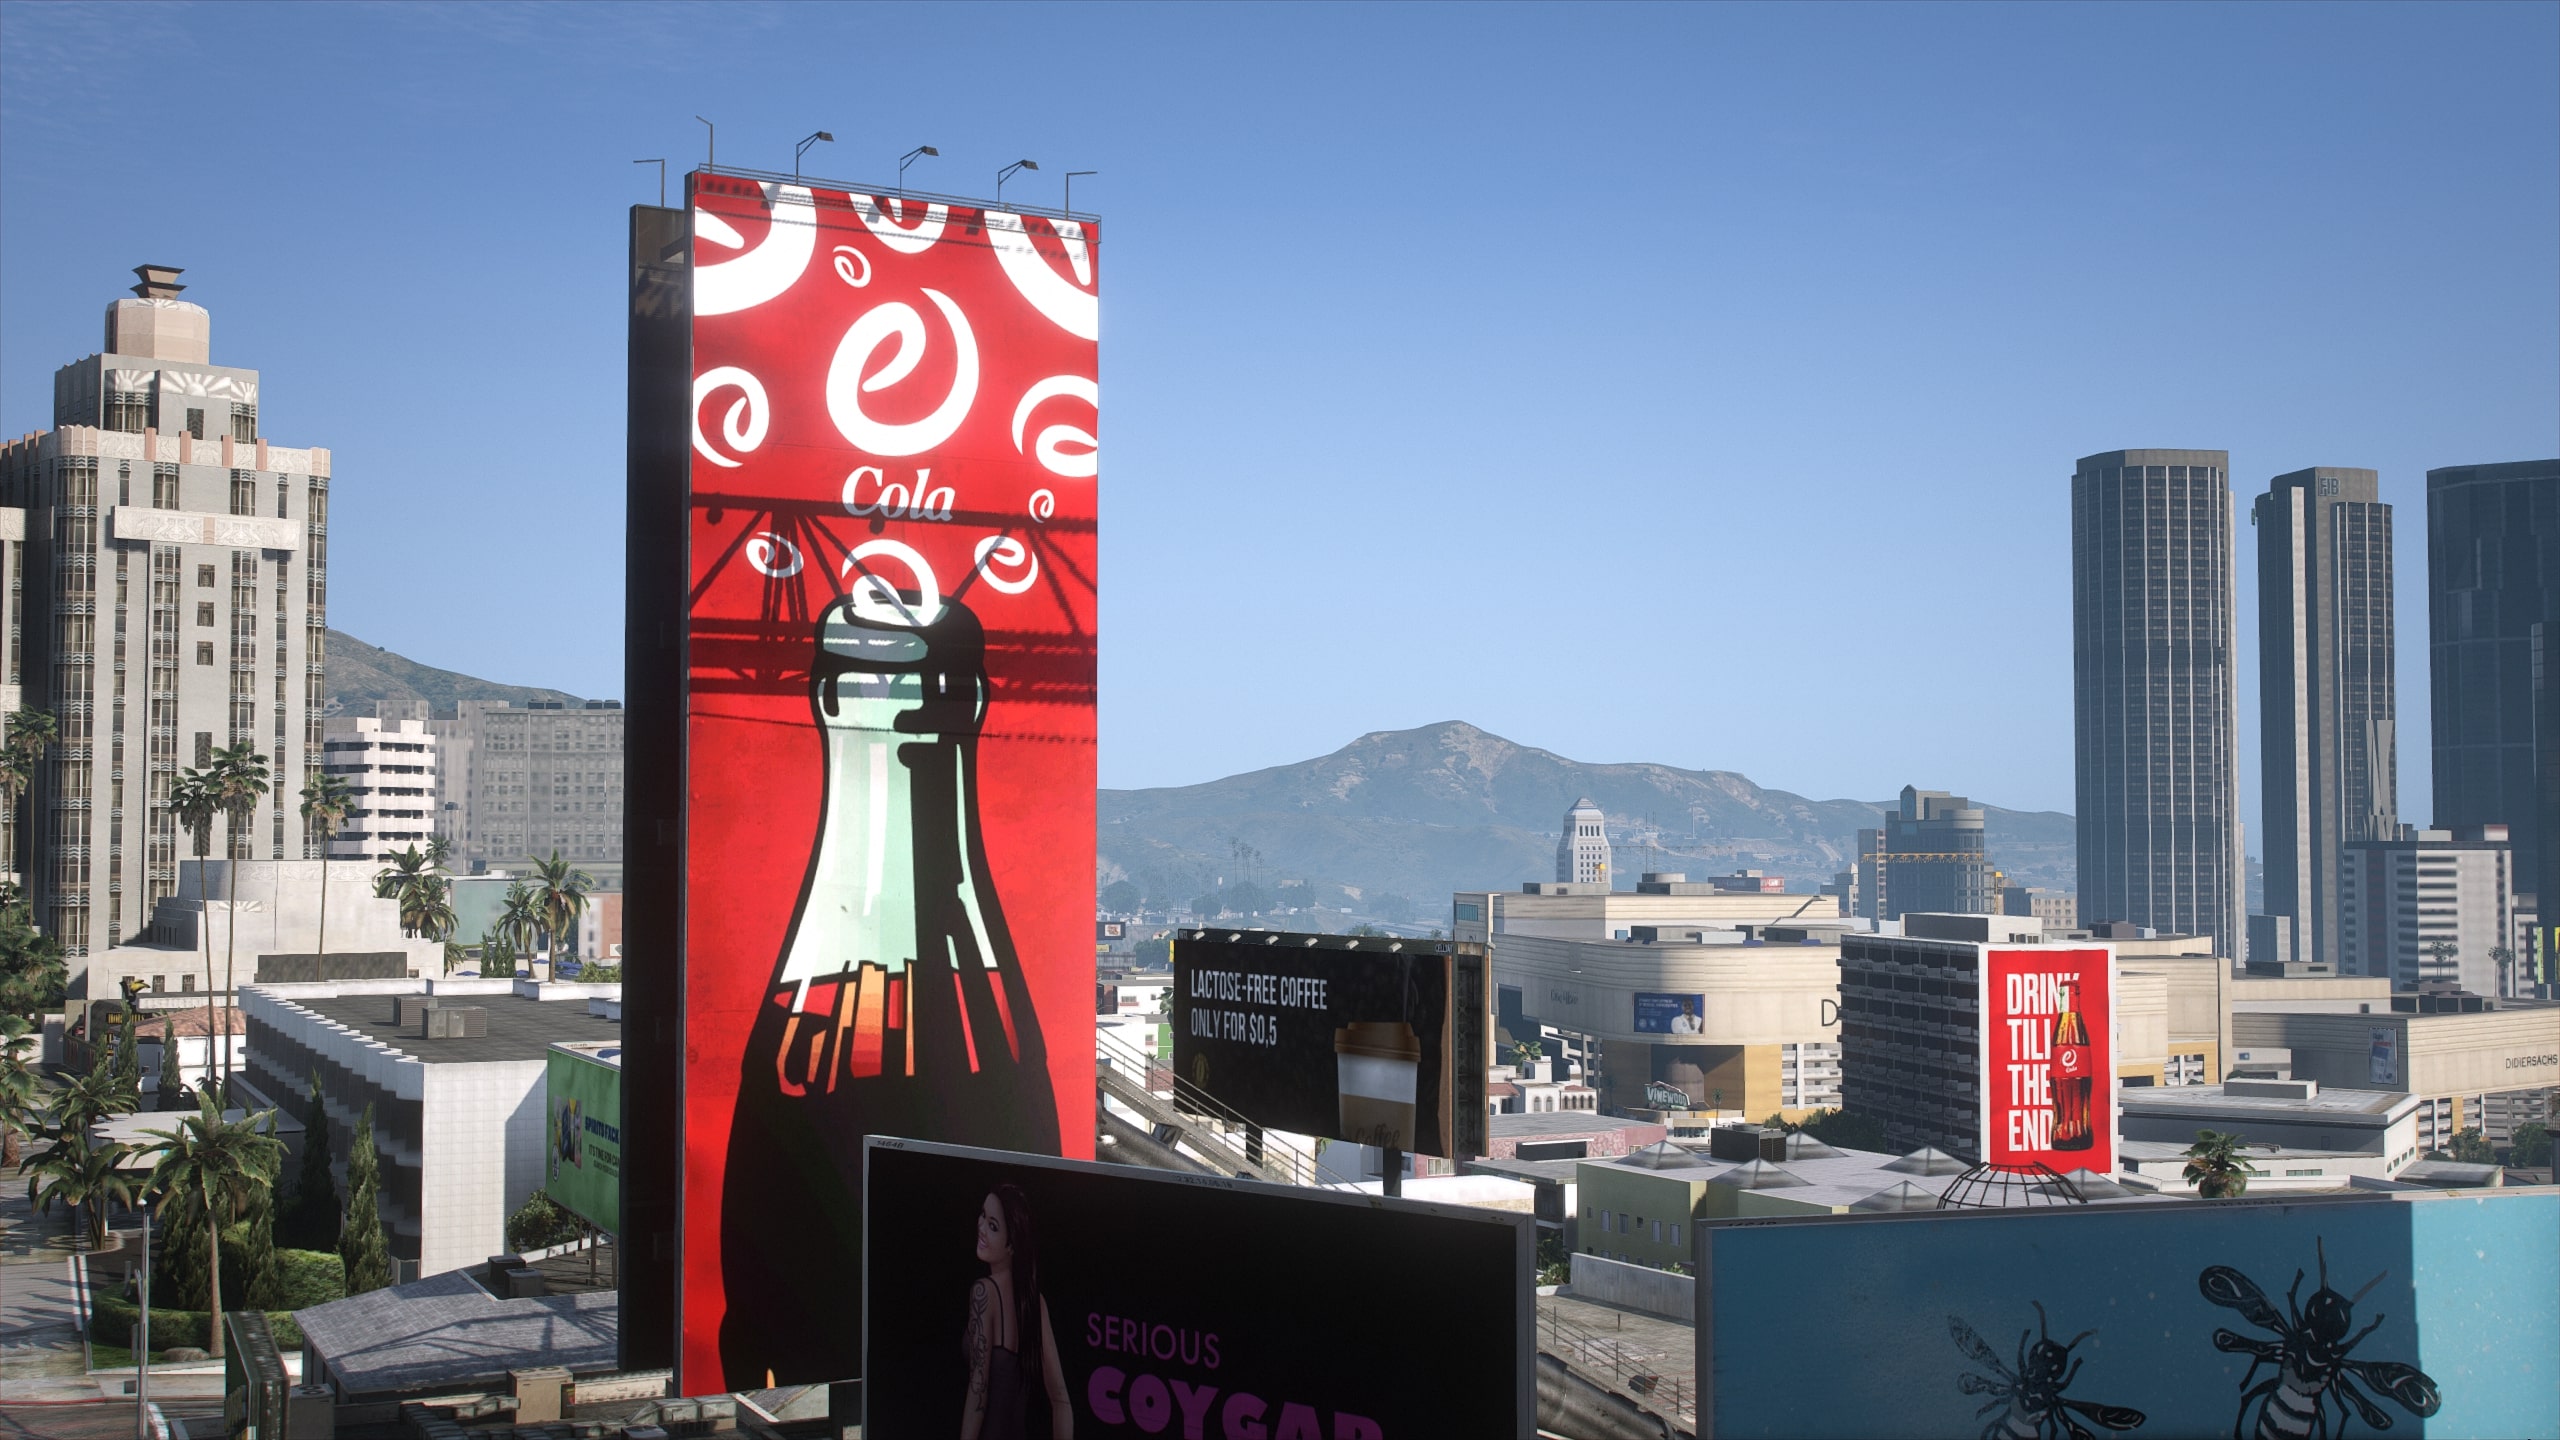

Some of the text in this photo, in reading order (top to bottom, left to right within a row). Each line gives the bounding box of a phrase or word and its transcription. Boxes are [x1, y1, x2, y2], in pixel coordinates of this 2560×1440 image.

[842, 466, 956, 521] Cola
[2318, 477, 2340, 496] FIB
[1191, 968, 1328, 1010] LACTOSE-FREE COFFEE
[1191, 1007, 1277, 1048] ONLY FOR $0,5
[1647, 1086, 1687, 1107] VINEWOOD
[2007, 1064, 2053, 1106] THE
[2008, 1109, 2054, 1152] END
[1086, 1312, 1220, 1369] SERIOUS
